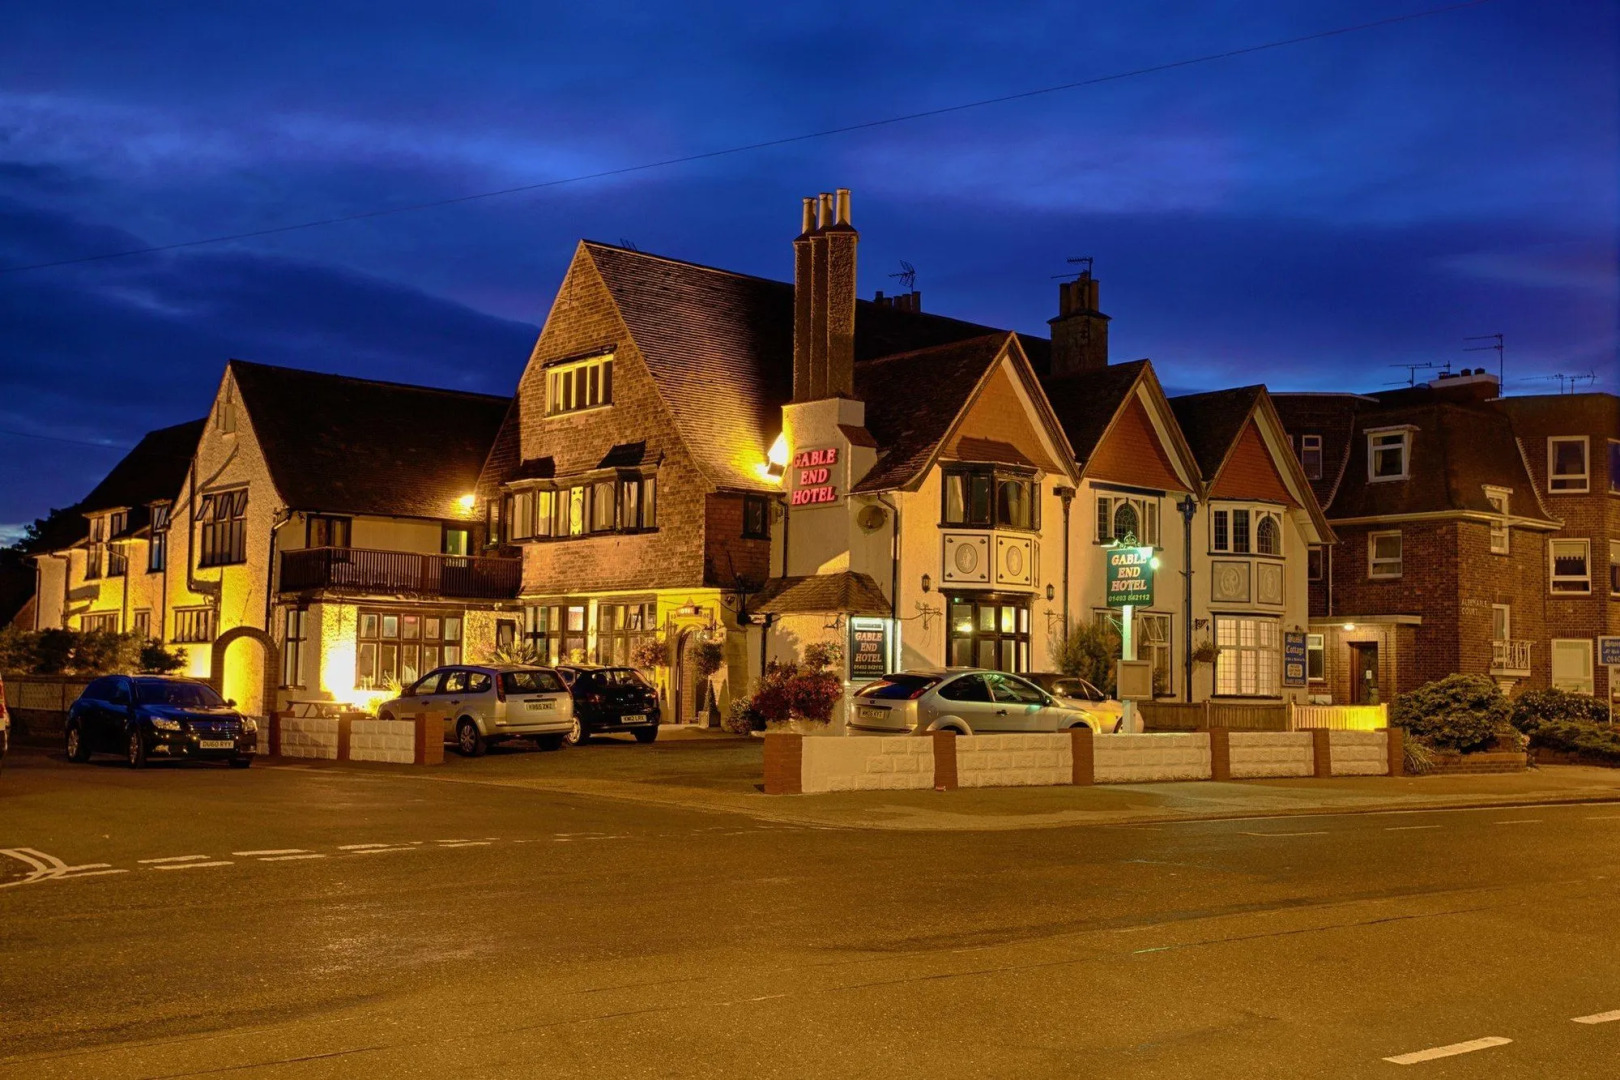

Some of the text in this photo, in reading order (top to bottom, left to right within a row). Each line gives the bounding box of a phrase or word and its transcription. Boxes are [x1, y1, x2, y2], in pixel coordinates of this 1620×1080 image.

[792, 447, 837, 468] GABLE
[799, 468, 828, 487] END
[791, 486, 836, 506] HOTEL
[1111, 553, 1148, 566] GABLE
[1117, 566, 1141, 579] END
[1111, 579, 1148, 592] HOTEL
[855, 632, 883, 642] GABLE
[860, 642, 878, 652] END
[855, 653, 882, 663] HOTEL
